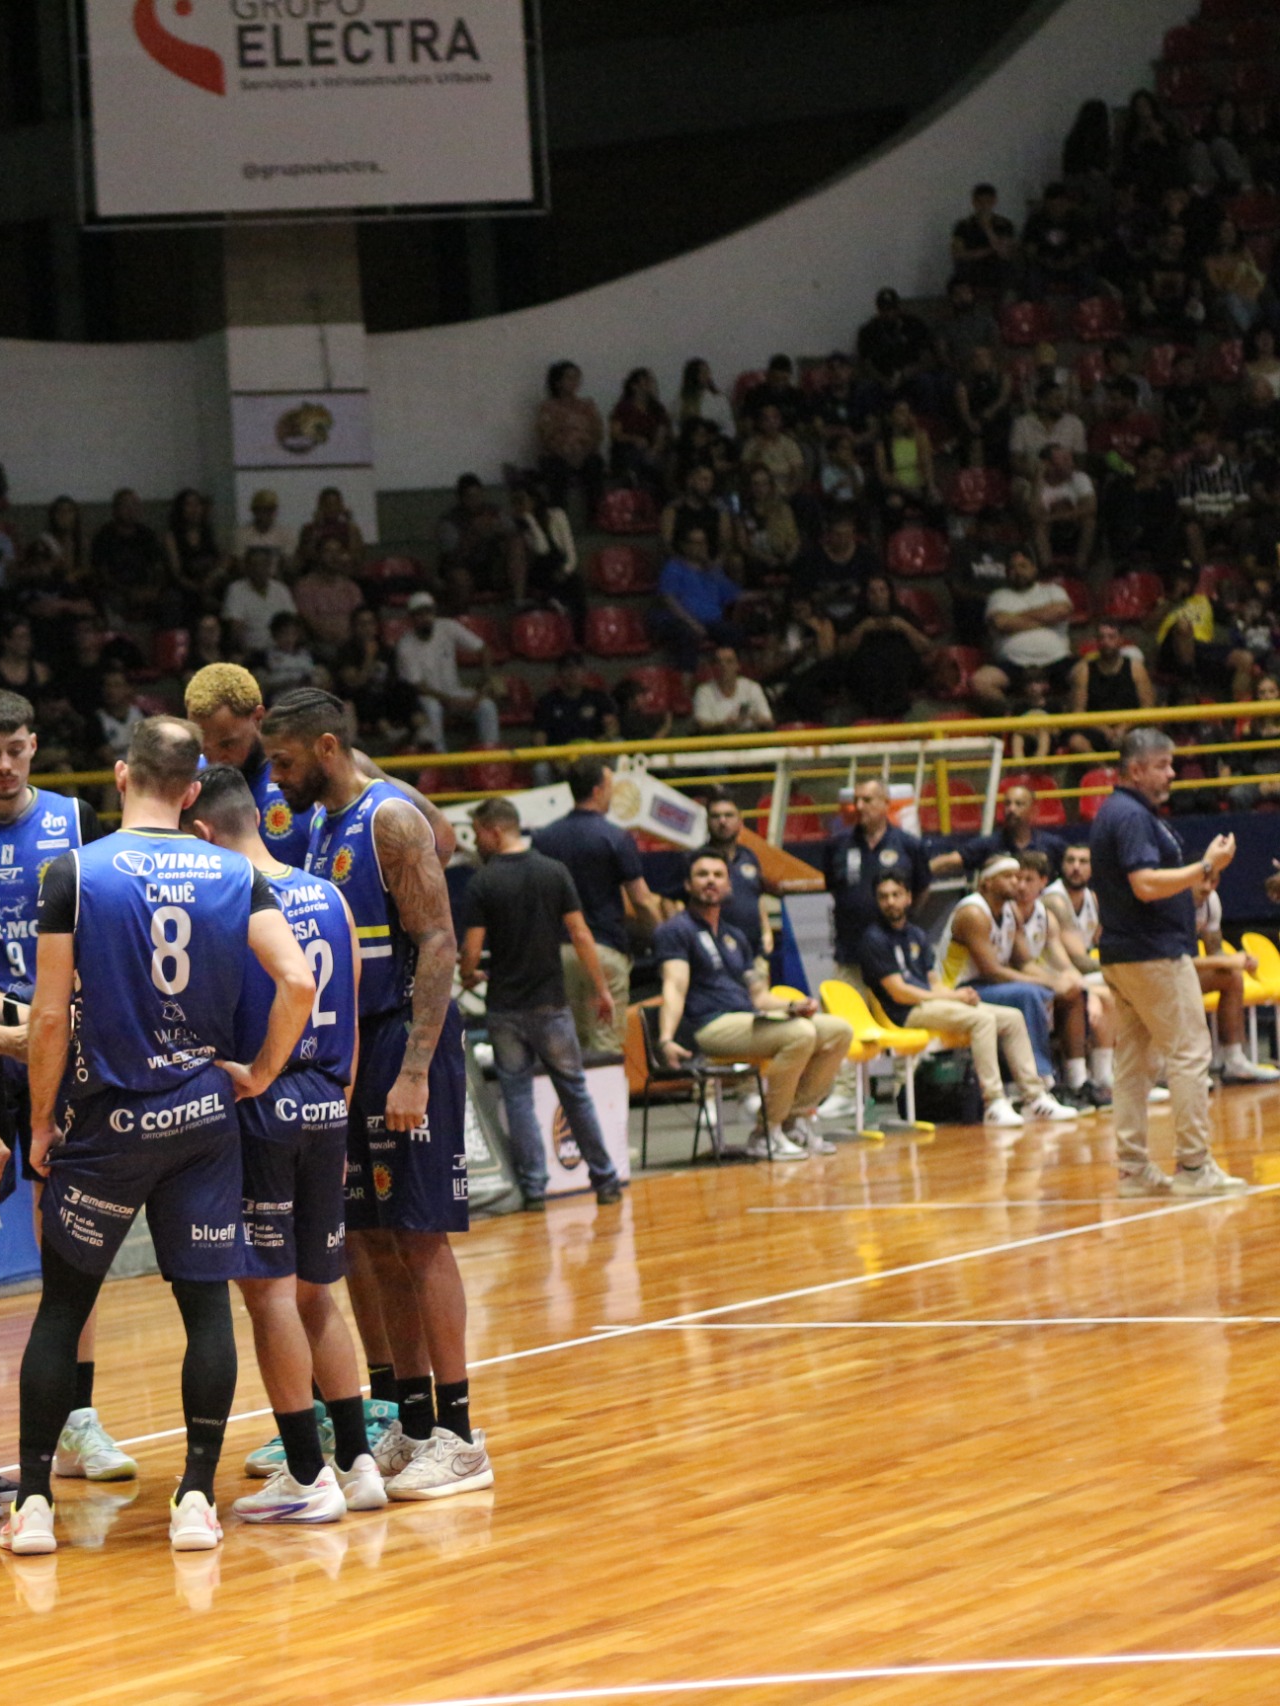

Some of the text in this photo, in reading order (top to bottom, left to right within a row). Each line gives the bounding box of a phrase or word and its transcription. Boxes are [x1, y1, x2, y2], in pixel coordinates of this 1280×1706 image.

[236, 17, 481, 68] ELECTRA
[154, 853, 222, 869] VINAC
[157, 870, 223, 880] consórcios
[146, 881, 196, 903] CAUÊ
[6, 941, 27, 977] 9
[150, 905, 193, 995] 8
[141, 1092, 225, 1131] COTREL
